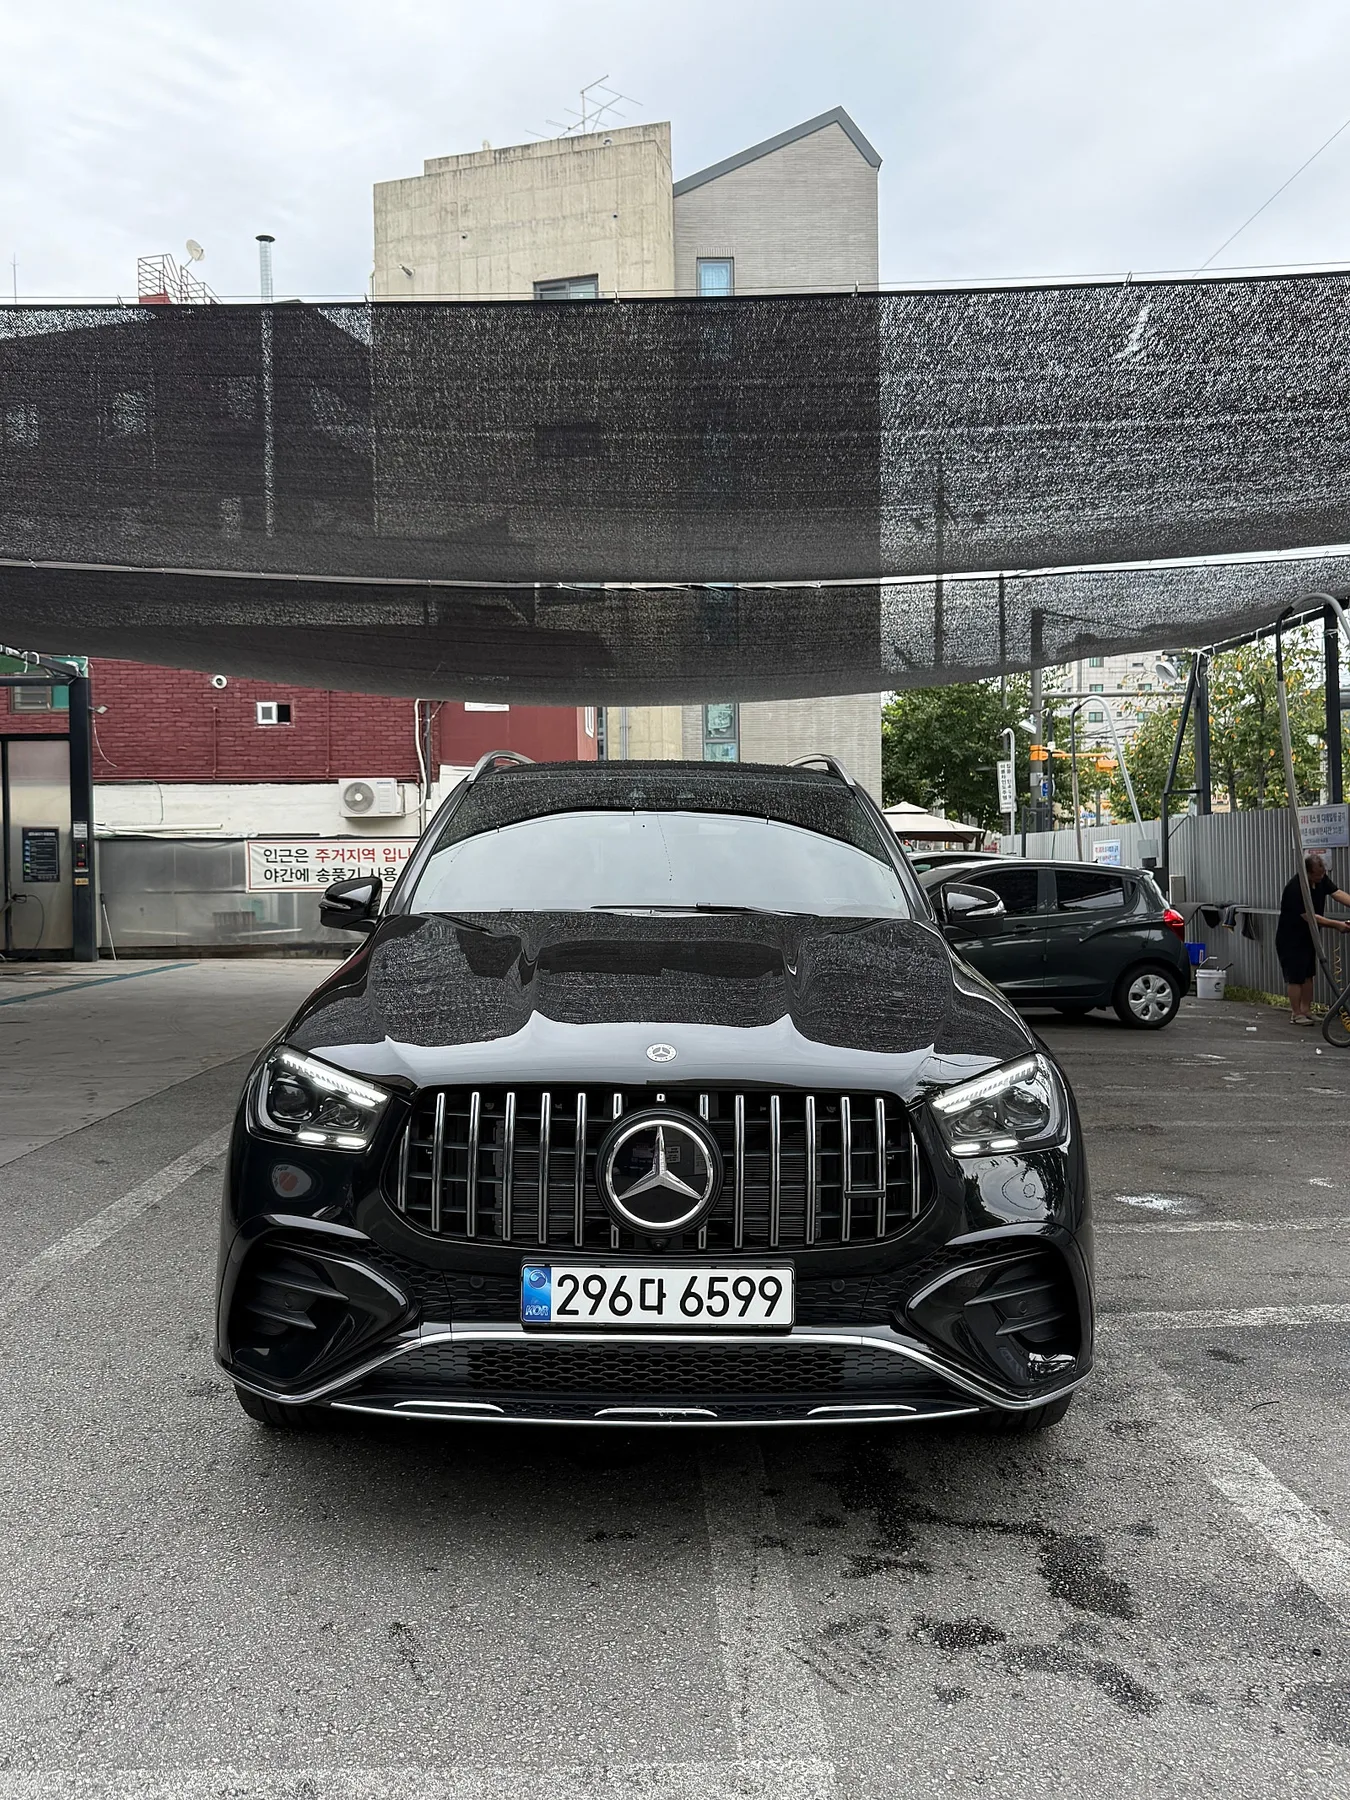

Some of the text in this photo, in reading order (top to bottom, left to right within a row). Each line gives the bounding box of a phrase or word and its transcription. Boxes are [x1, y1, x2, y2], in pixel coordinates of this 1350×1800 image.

[263, 848, 411, 863] 인근은 주거지역 입니
[264, 868, 309, 883] 야간에
[316, 867, 361, 883] 송풍기
[556, 1274, 783, 1317] 296다 6599
[525, 1304, 549, 1316] KOR
